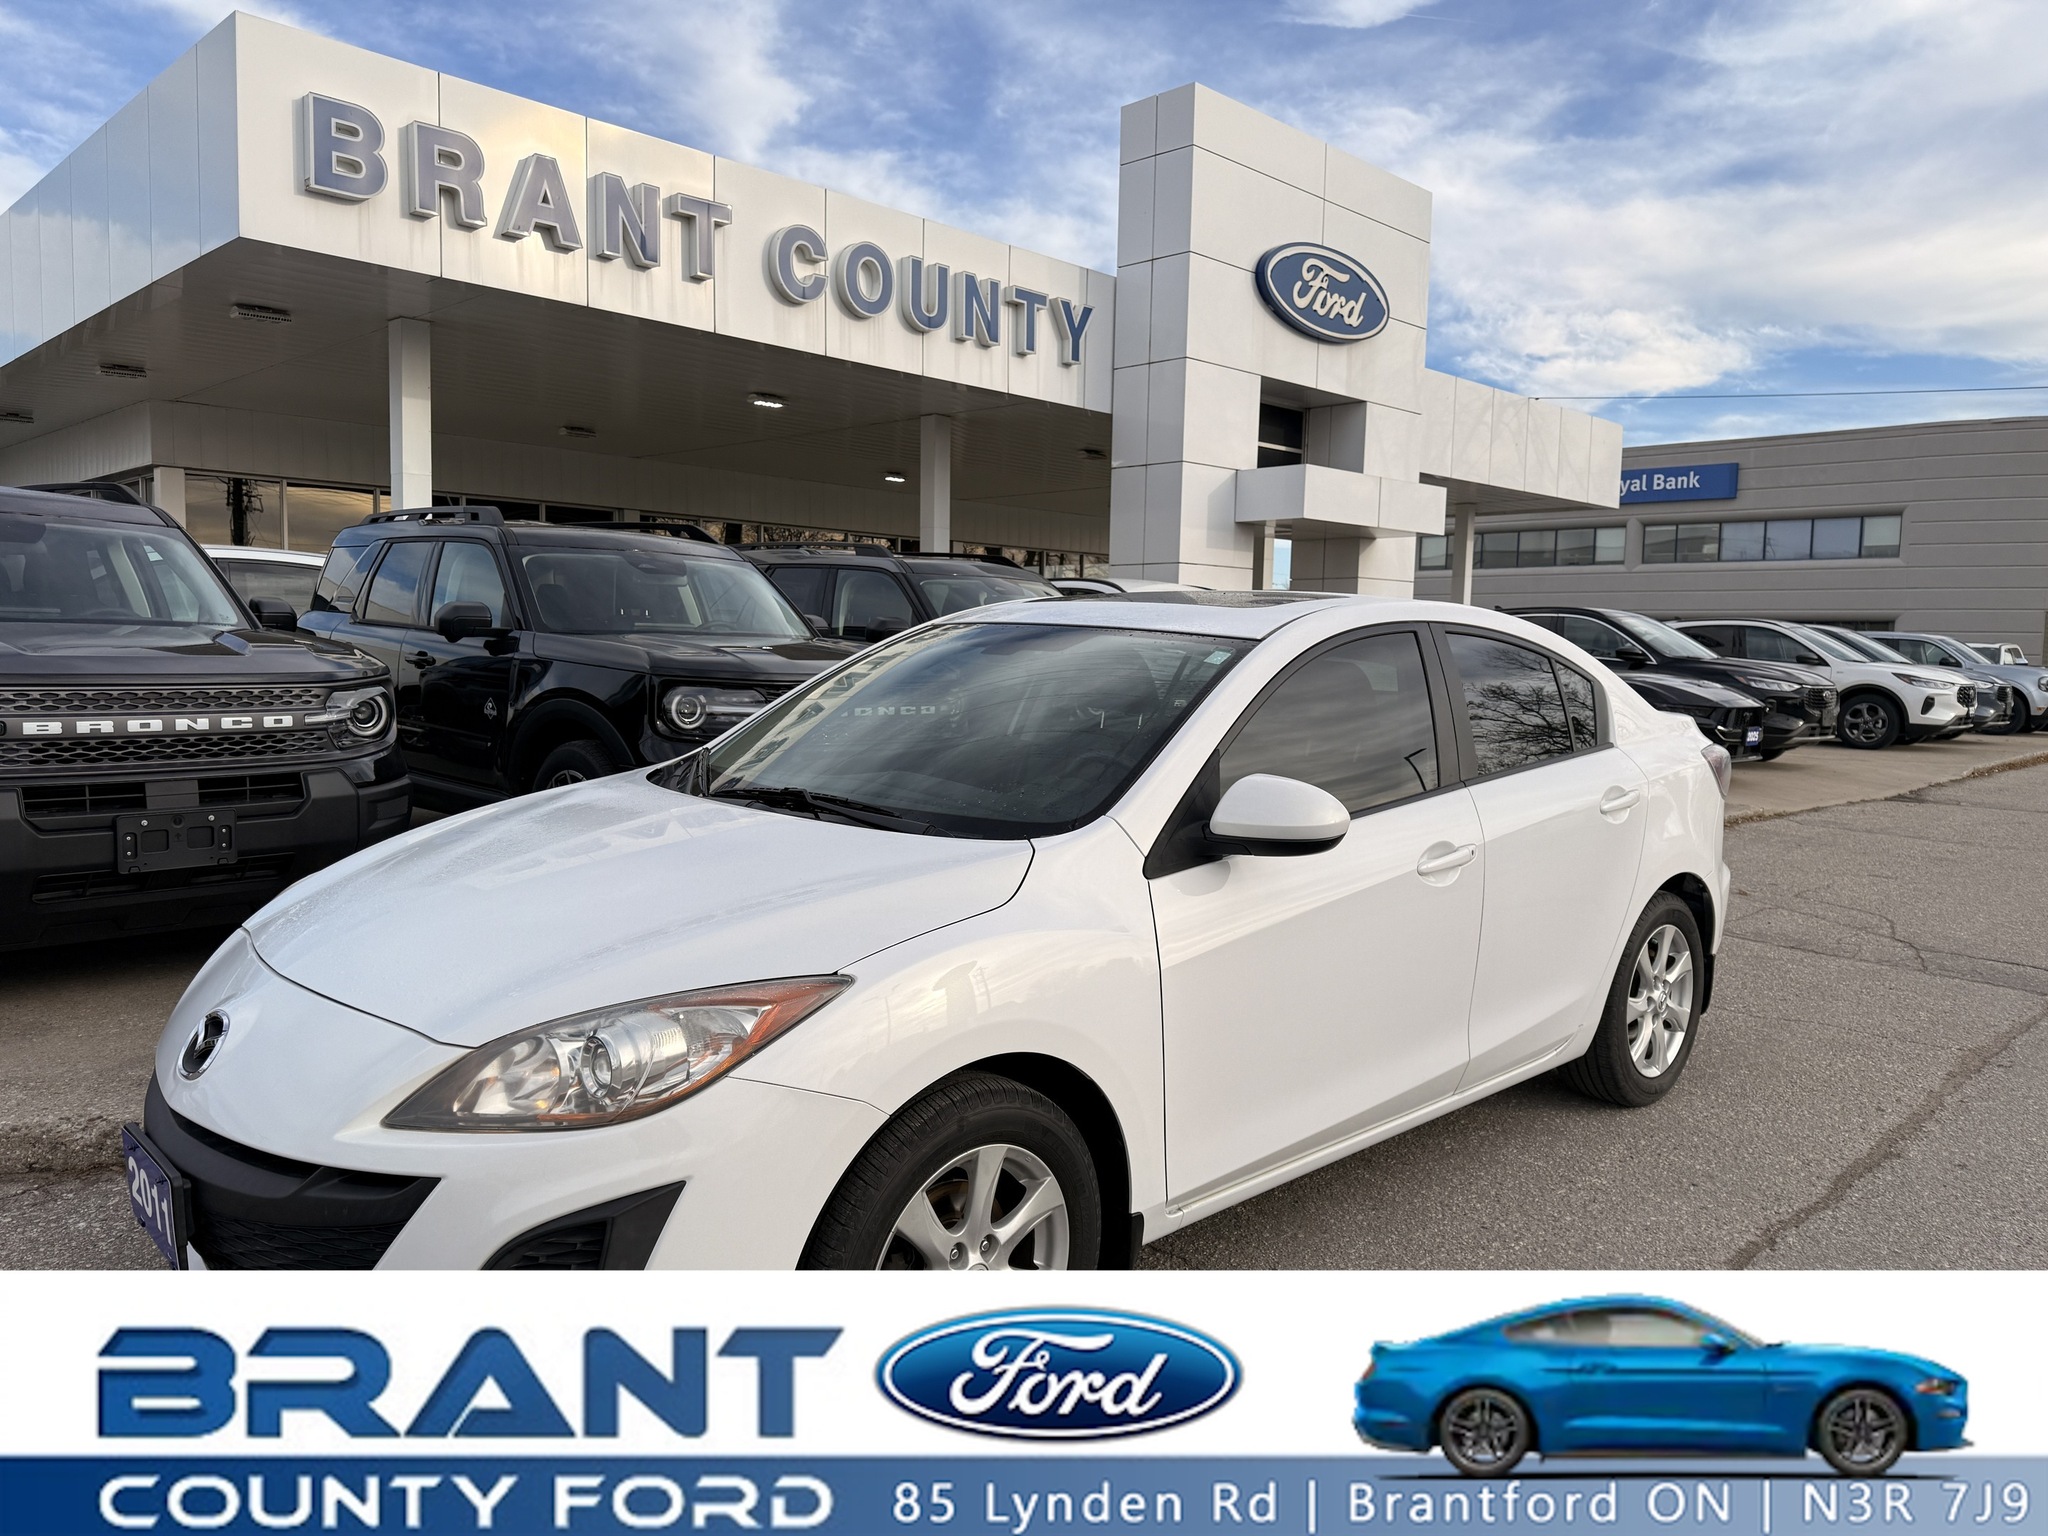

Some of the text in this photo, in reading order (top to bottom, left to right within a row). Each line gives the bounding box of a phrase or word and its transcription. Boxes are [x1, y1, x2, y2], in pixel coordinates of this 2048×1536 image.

[303, 91, 1096, 367] BRANT COUNTY
[1292, 257, 1367, 328] Ford
[1620, 471, 1700, 496] yal Bank
[22, 715, 294, 735] BRONCO
[127, 1155, 173, 1247] 2011
